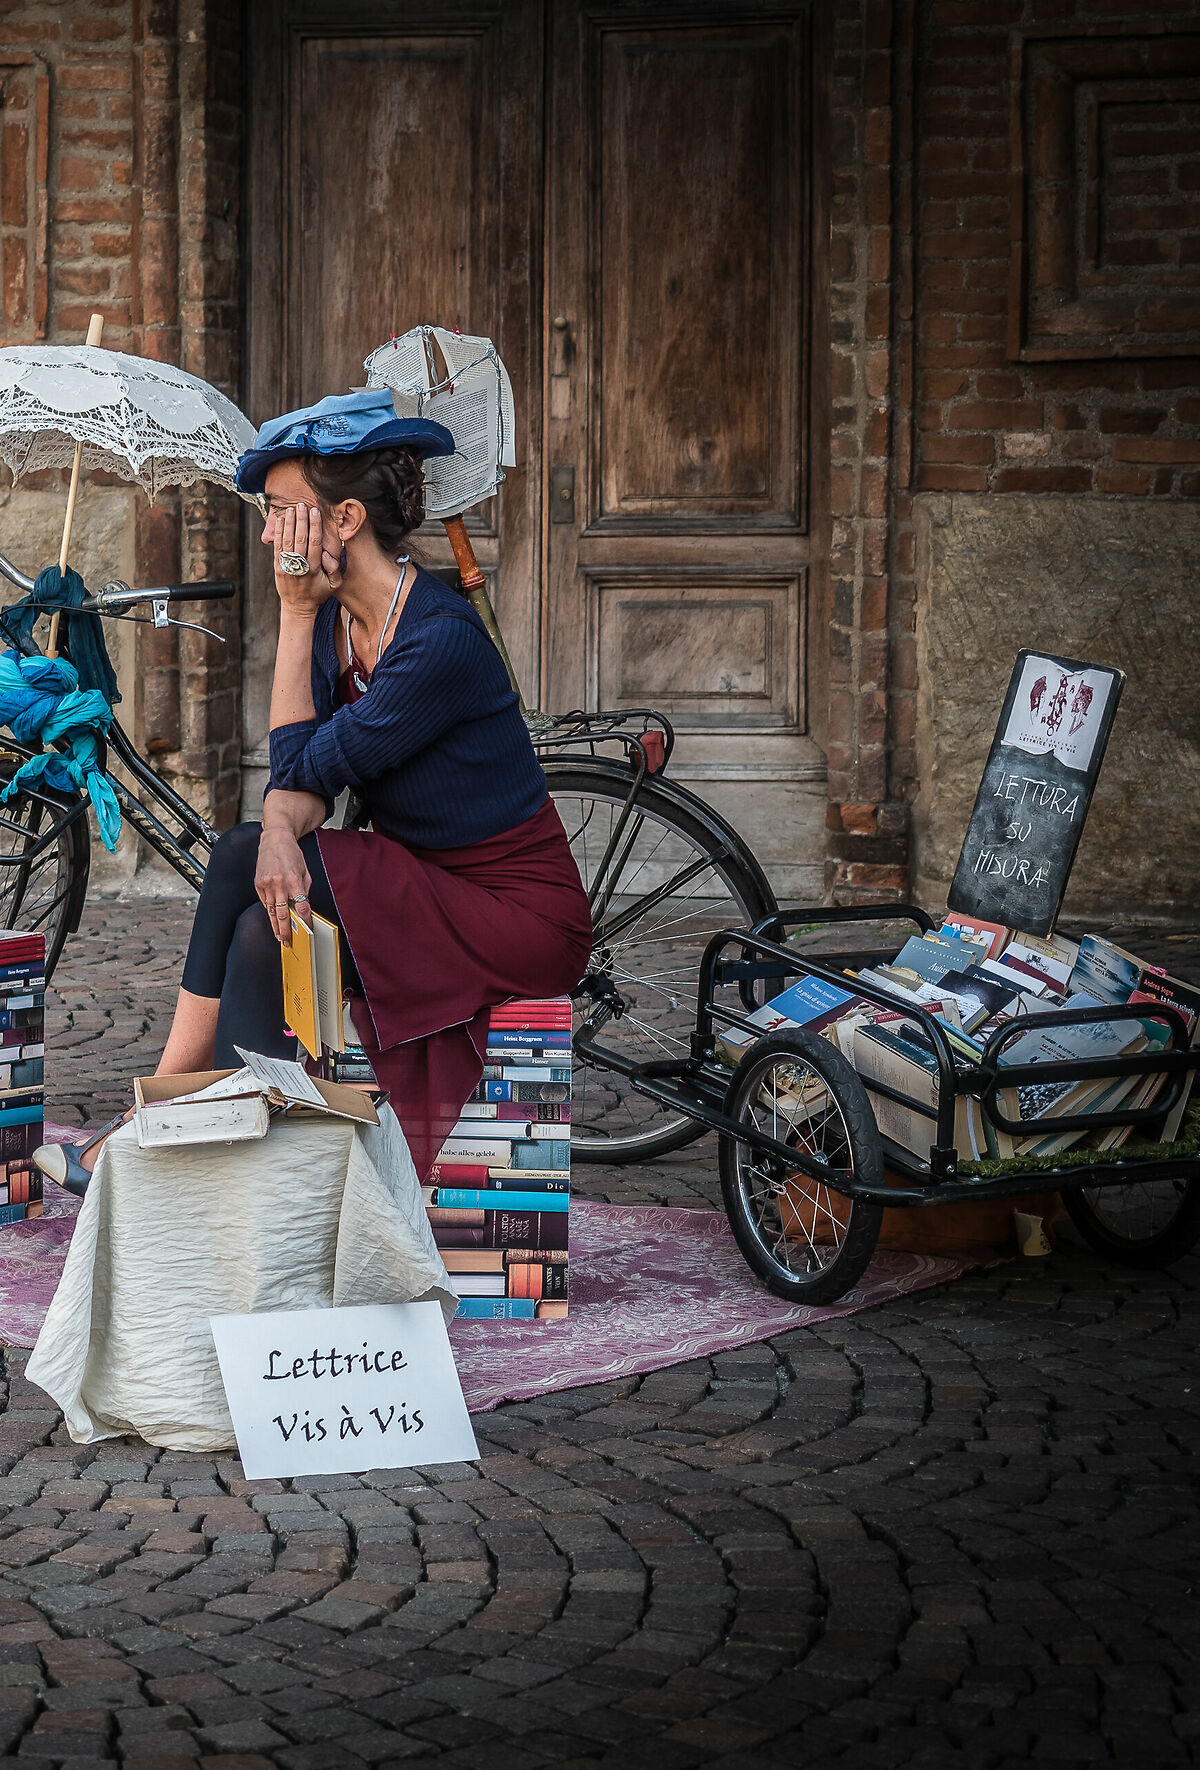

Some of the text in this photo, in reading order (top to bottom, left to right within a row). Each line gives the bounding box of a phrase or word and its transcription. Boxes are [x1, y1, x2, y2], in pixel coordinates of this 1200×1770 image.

[1019, 736, 1046, 747] LETTRICE
[993, 771, 1080, 822] LETTURA
[1006, 822, 1032, 842] SU
[973, 849, 1049, 889] MISURA
[1143, 978, 1160, 991] Andrea
[1166, 998, 1179, 1009] terra
[440, 1149, 497, 1159] habe alles gelebt
[547, 1182, 565, 1190] Die
[262, 1341, 408, 1381] Lettrice
[271, 1401, 425, 1442] Vis à Vis
